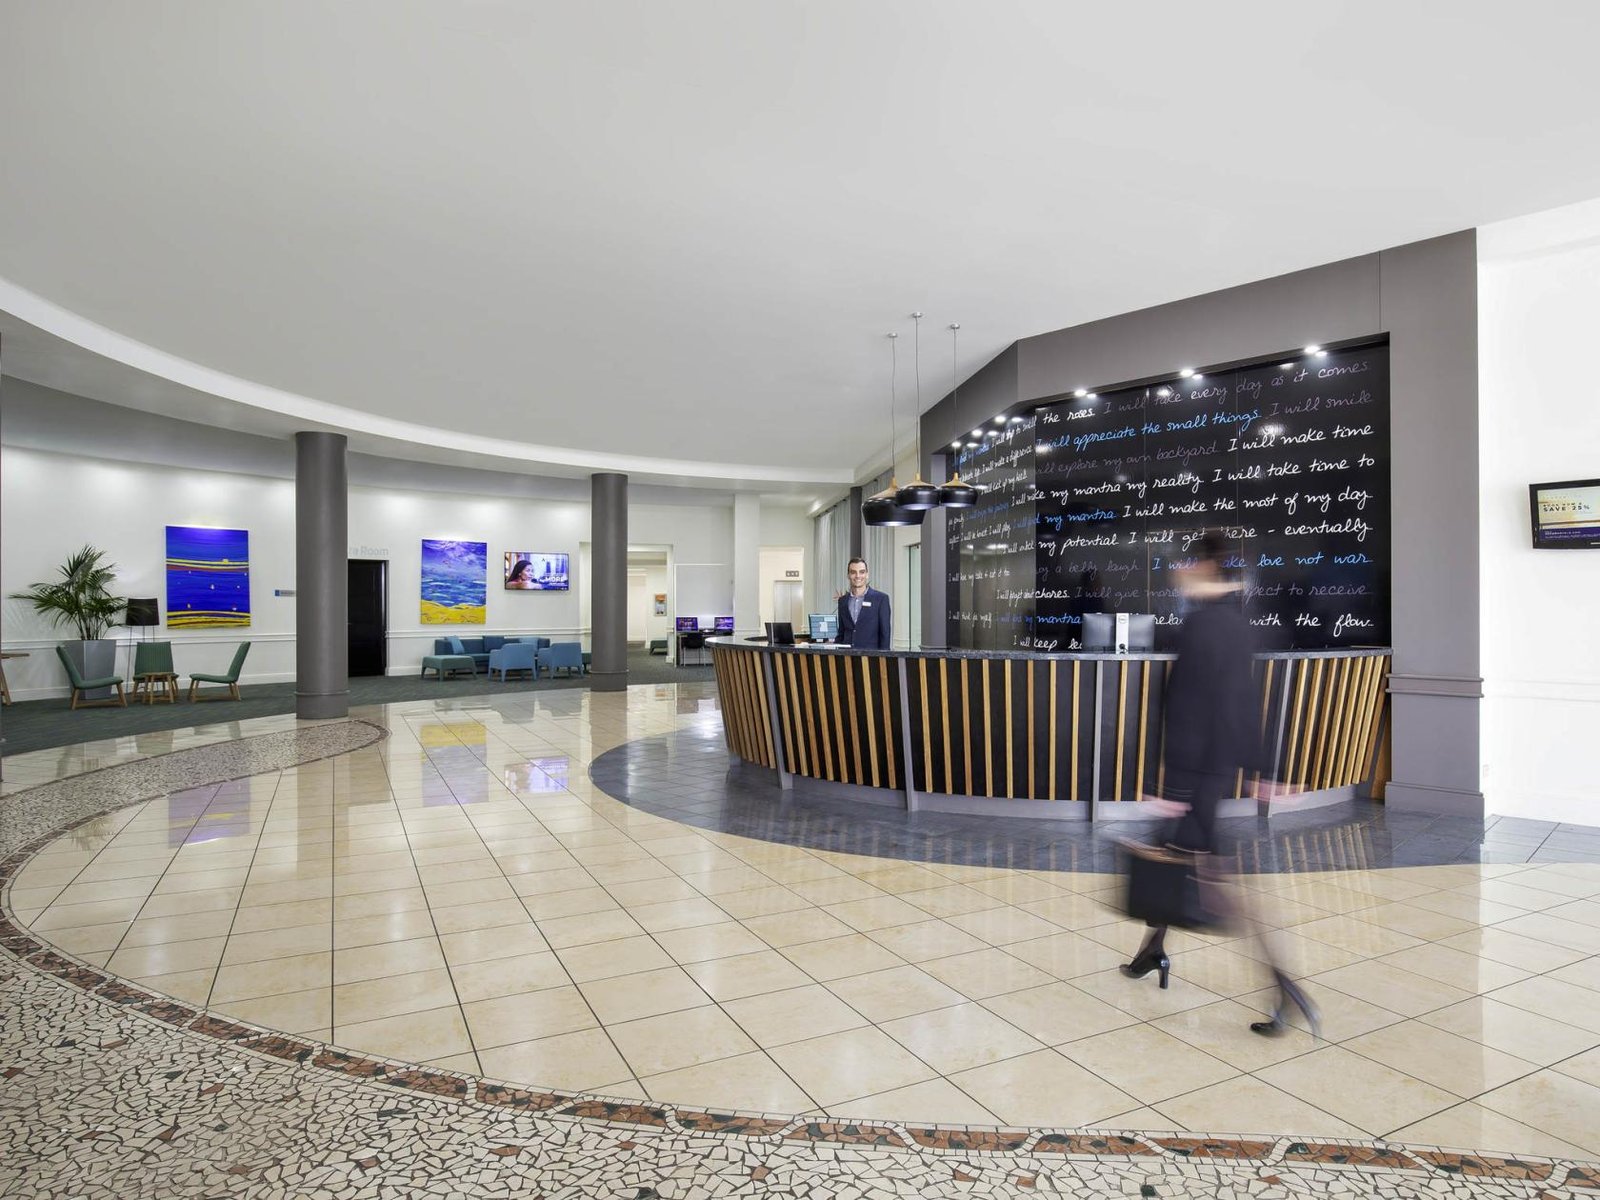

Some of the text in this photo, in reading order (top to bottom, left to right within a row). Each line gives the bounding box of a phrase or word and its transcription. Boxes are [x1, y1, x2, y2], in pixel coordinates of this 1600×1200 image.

[1042, 412, 1061, 424] the
[1104, 402, 1112, 414] I
[1118, 397, 1147, 412] will
[1154, 385, 1181, 405] take
[1190, 384, 1228, 404] every
[1236, 377, 1262, 399] day
[1271, 374, 1284, 387] as
[1293, 368, 1308, 382] it
[1317, 360, 1369, 379] comes
[1046, 435, 1070, 449] will
[1073, 428, 1136, 451] appreciate
[1141, 422, 1162, 434] the
[1166, 414, 1208, 431] small
[1211, 408, 1262, 432] things
[1269, 402, 1280, 416] I
[1285, 397, 1320, 414] will
[1325, 390, 1373, 409] smile
[1058, 459, 1098, 478] explore
[1104, 457, 1123, 474] my
[1126, 453, 1151, 464] own
[1156, 440, 1217, 466] backyard
[1227, 438, 1238, 452] I
[1242, 432, 1275, 449] will
[1281, 427, 1326, 445] make
[1332, 424, 1374, 438] time
[1050, 490, 1069, 505] my
[1073, 481, 1121, 496] mantra
[1126, 481, 1148, 498] my
[1152, 472, 1204, 493] reality
[1211, 469, 1222, 482] I
[1227, 465, 1262, 480] will
[1266, 462, 1302, 477] take
[1309, 459, 1350, 472] time
[1357, 453, 1375, 467] to
[1045, 514, 1063, 531] my
[1067, 508, 1117, 521] mantra
[1123, 505, 1131, 517] I
[1135, 503, 1164, 517] will
[1168, 500, 1208, 514] make
[1213, 498, 1237, 510] the
[1244, 492, 1278, 508] most
[1284, 492, 1299, 515] of
[1304, 494, 1332, 513] my
[1338, 485, 1373, 510] day
[1038, 540, 1057, 556] my
[1060, 533, 1120, 555] potential
[1127, 531, 1137, 544] I
[1144, 529, 1175, 543] will
[1182, 527, 1207, 551] get
[1284, 517, 1373, 542] eventually
[1055, 565, 1062, 573] a
[1068, 561, 1097, 580] belly
[1105, 559, 1141, 581] laugh
[1151, 557, 1161, 570] I
[1168, 557, 1198, 571] will
[1221, 555, 1248, 568] ake
[1257, 553, 1285, 568] love
[1295, 551, 1324, 565] not
[1334, 553, 1373, 564] war
[1035, 587, 1070, 599] chores
[1074, 587, 1083, 599] I
[1085, 587, 1112, 599] will
[1114, 588, 1140, 607] give
[1288, 583, 1304, 595] to
[1308, 583, 1373, 596] receive
[1037, 613, 1082, 624] mantra
[1248, 613, 1282, 626] with
[1295, 613, 1321, 626] the
